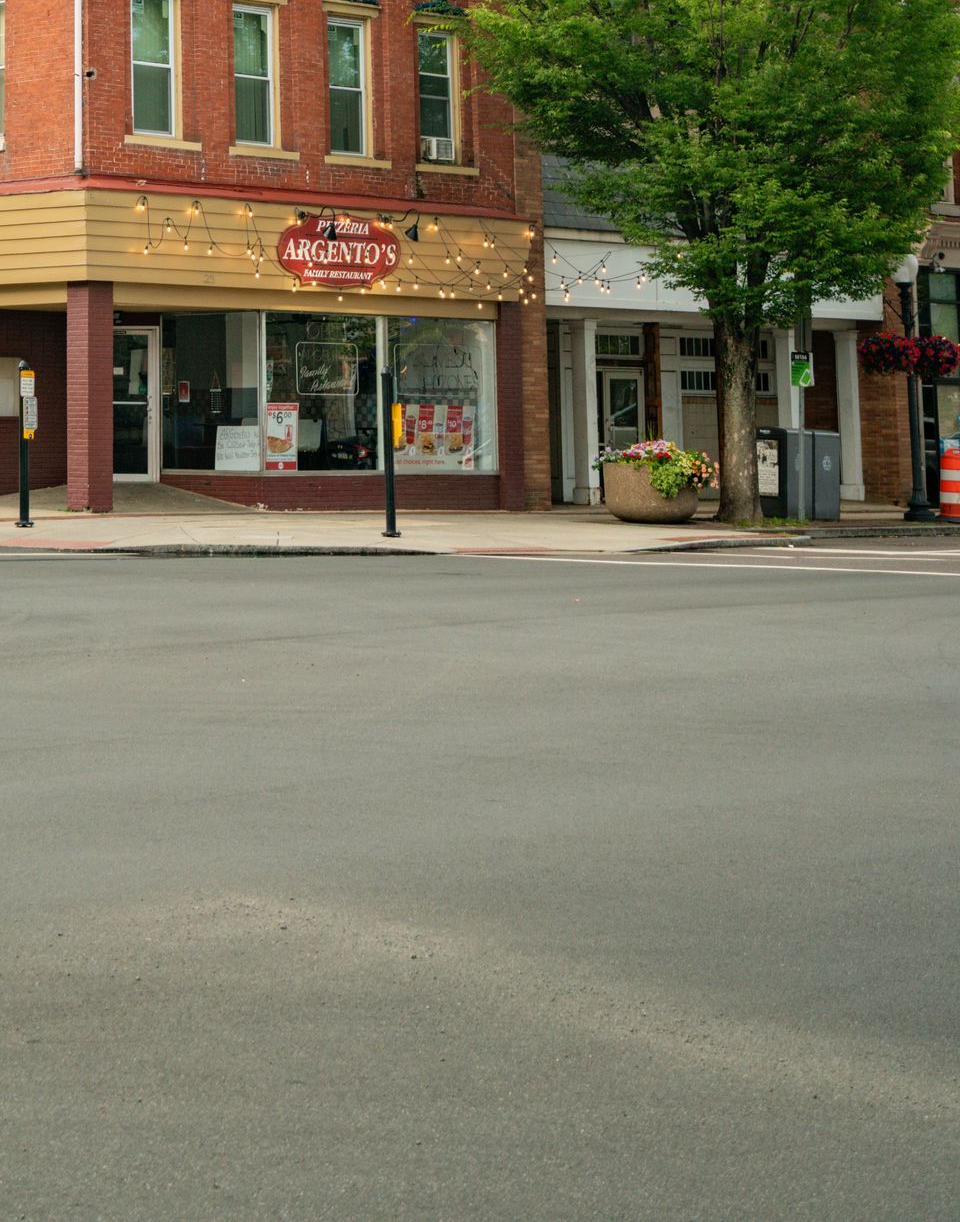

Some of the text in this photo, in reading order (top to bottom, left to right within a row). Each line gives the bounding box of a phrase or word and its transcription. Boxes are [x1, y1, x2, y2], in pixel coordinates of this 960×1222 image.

[282, 237, 397, 266] ARGENTO'S
[303, 268, 374, 280] FAMILY RESTAURANT
